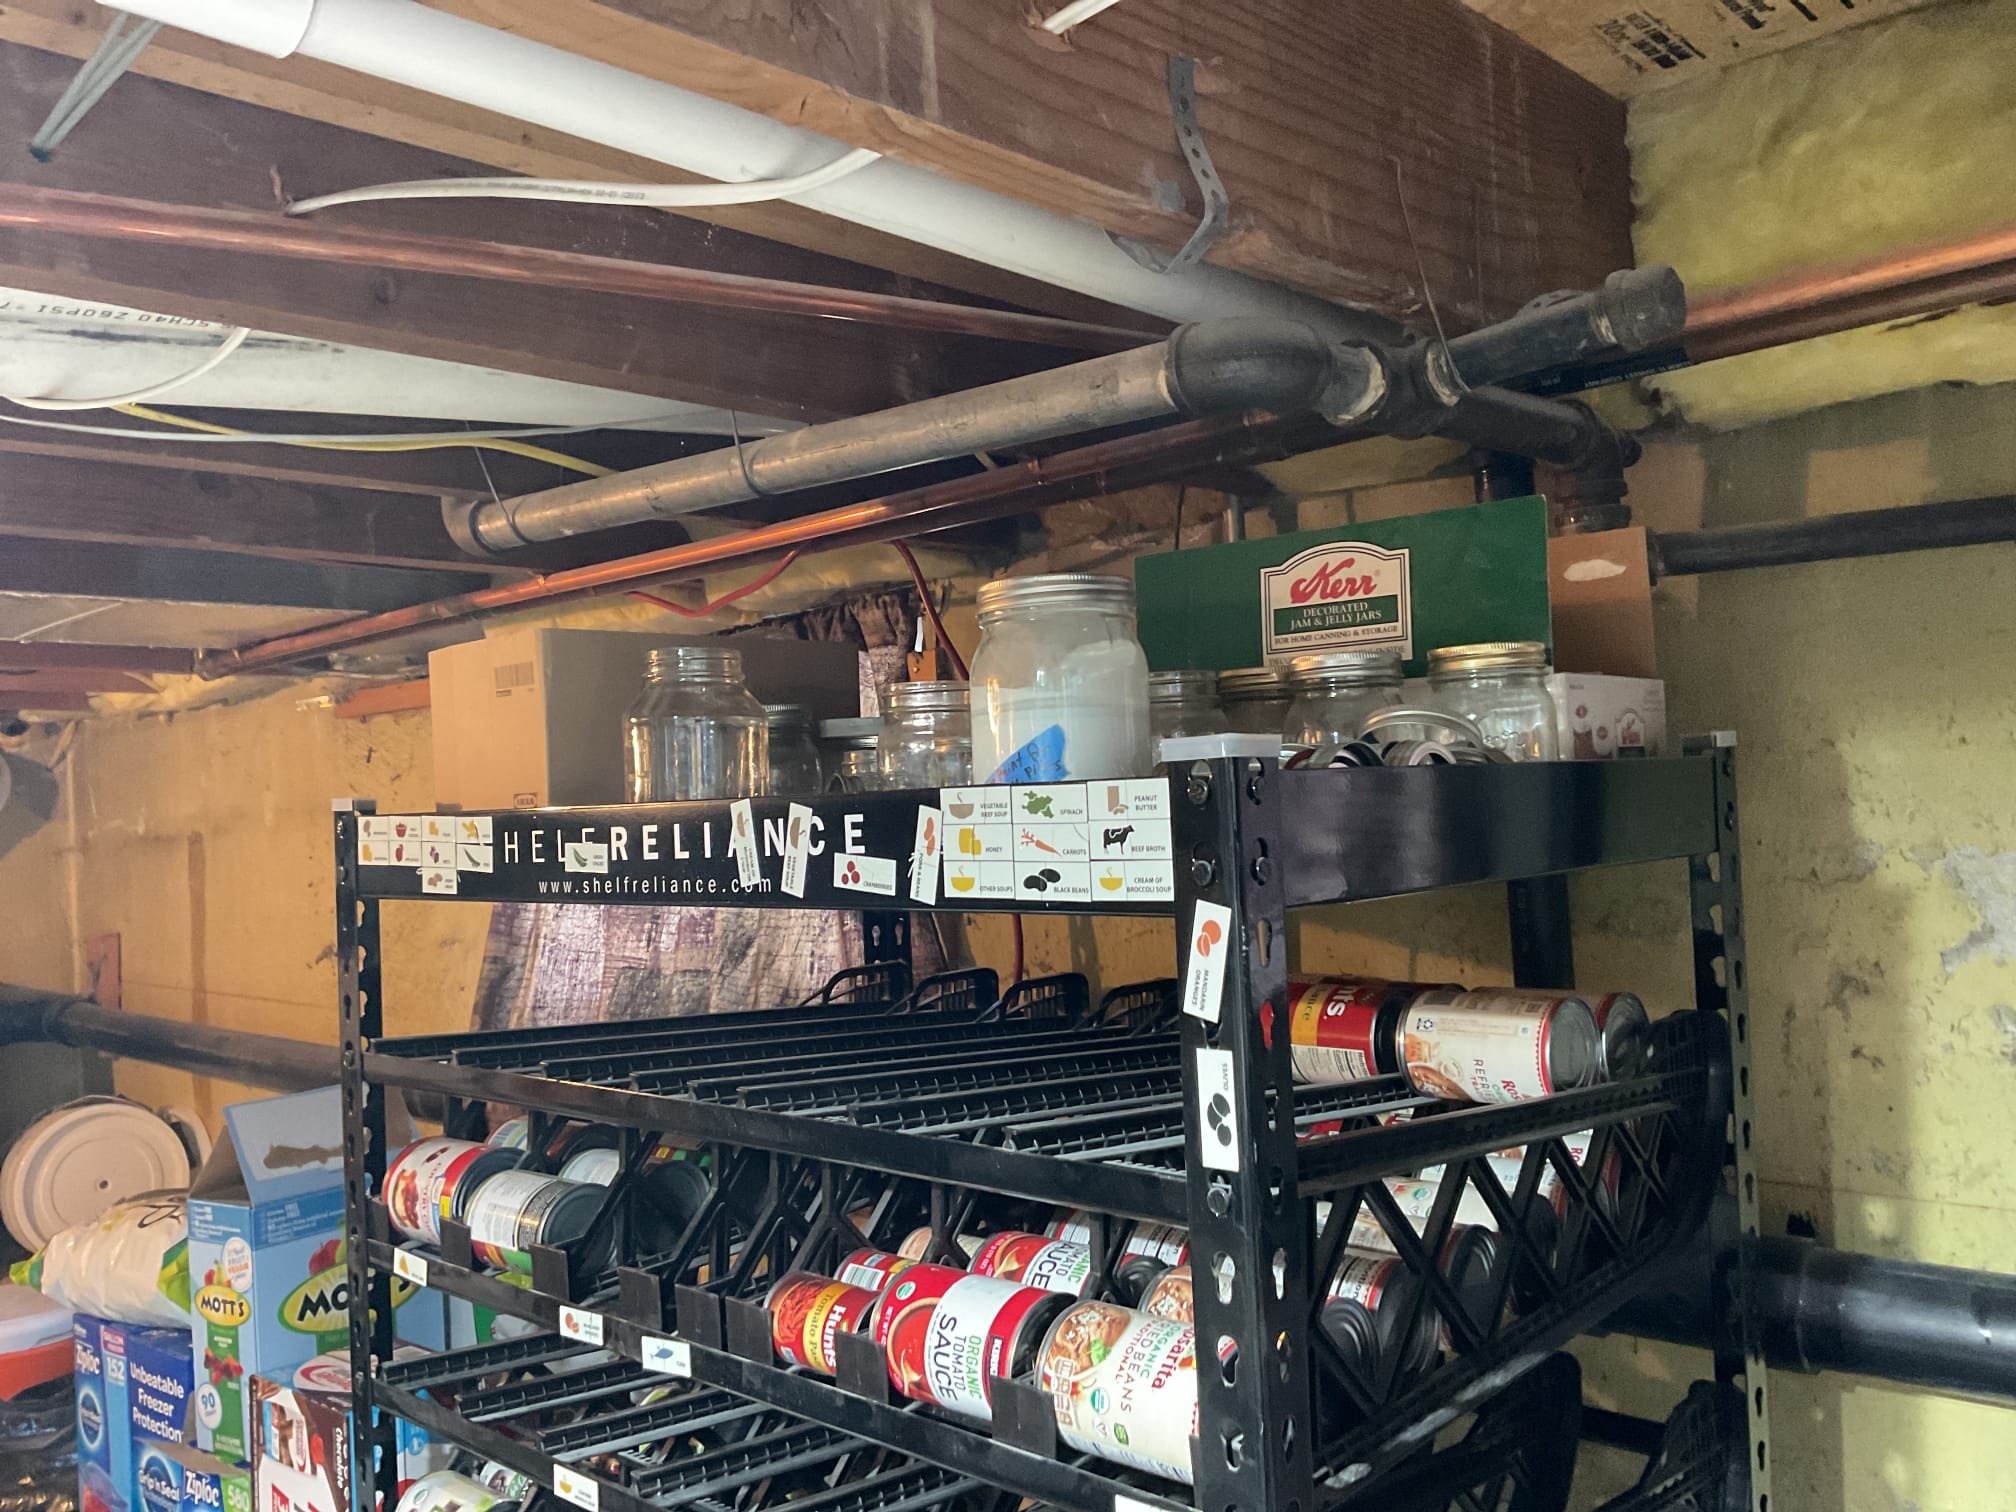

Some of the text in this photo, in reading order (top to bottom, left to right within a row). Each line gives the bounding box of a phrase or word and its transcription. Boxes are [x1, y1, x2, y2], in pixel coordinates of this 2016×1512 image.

[1290, 557, 1378, 604] Kerr
[1290, 609, 1382, 631] JAM & JELLY JARS
[1303, 602, 1369, 617] DECORATED
[1274, 625, 1398, 645] FOR HOME CANNING & STORAGE
[1062, 848, 1087, 856] CARROTS
[863, 881, 893, 891] CRANBERRIES
[1031, 1242, 1072, 1289] AUCE
[200, 1295, 245, 1318] MOTT'S
[809, 1293, 836, 1337] Tomato
[76, 1341, 101, 1375] Ziploc
[106, 1356, 125, 1379] 152
[929, 1315, 958, 1402] SAUCE
[952, 1335, 968, 1392] TOMATO
[967, 1335, 983, 1400] ORGANIC
[1140, 1323, 1182, 1379] ORGANIC
[130, 1361, 185, 1398] Unbeatable
[1120, 1351, 1147, 1413] BEANS
[138, 1388, 175, 1417] Freezer
[201, 1391, 216, 1409] 90
[132, 1406, 182, 1443] Protection
[335, 1427, 344, 1489] Chocolate
[185, 1470, 220, 1507] Ziploc
[227, 1484, 250, 1511] 580
